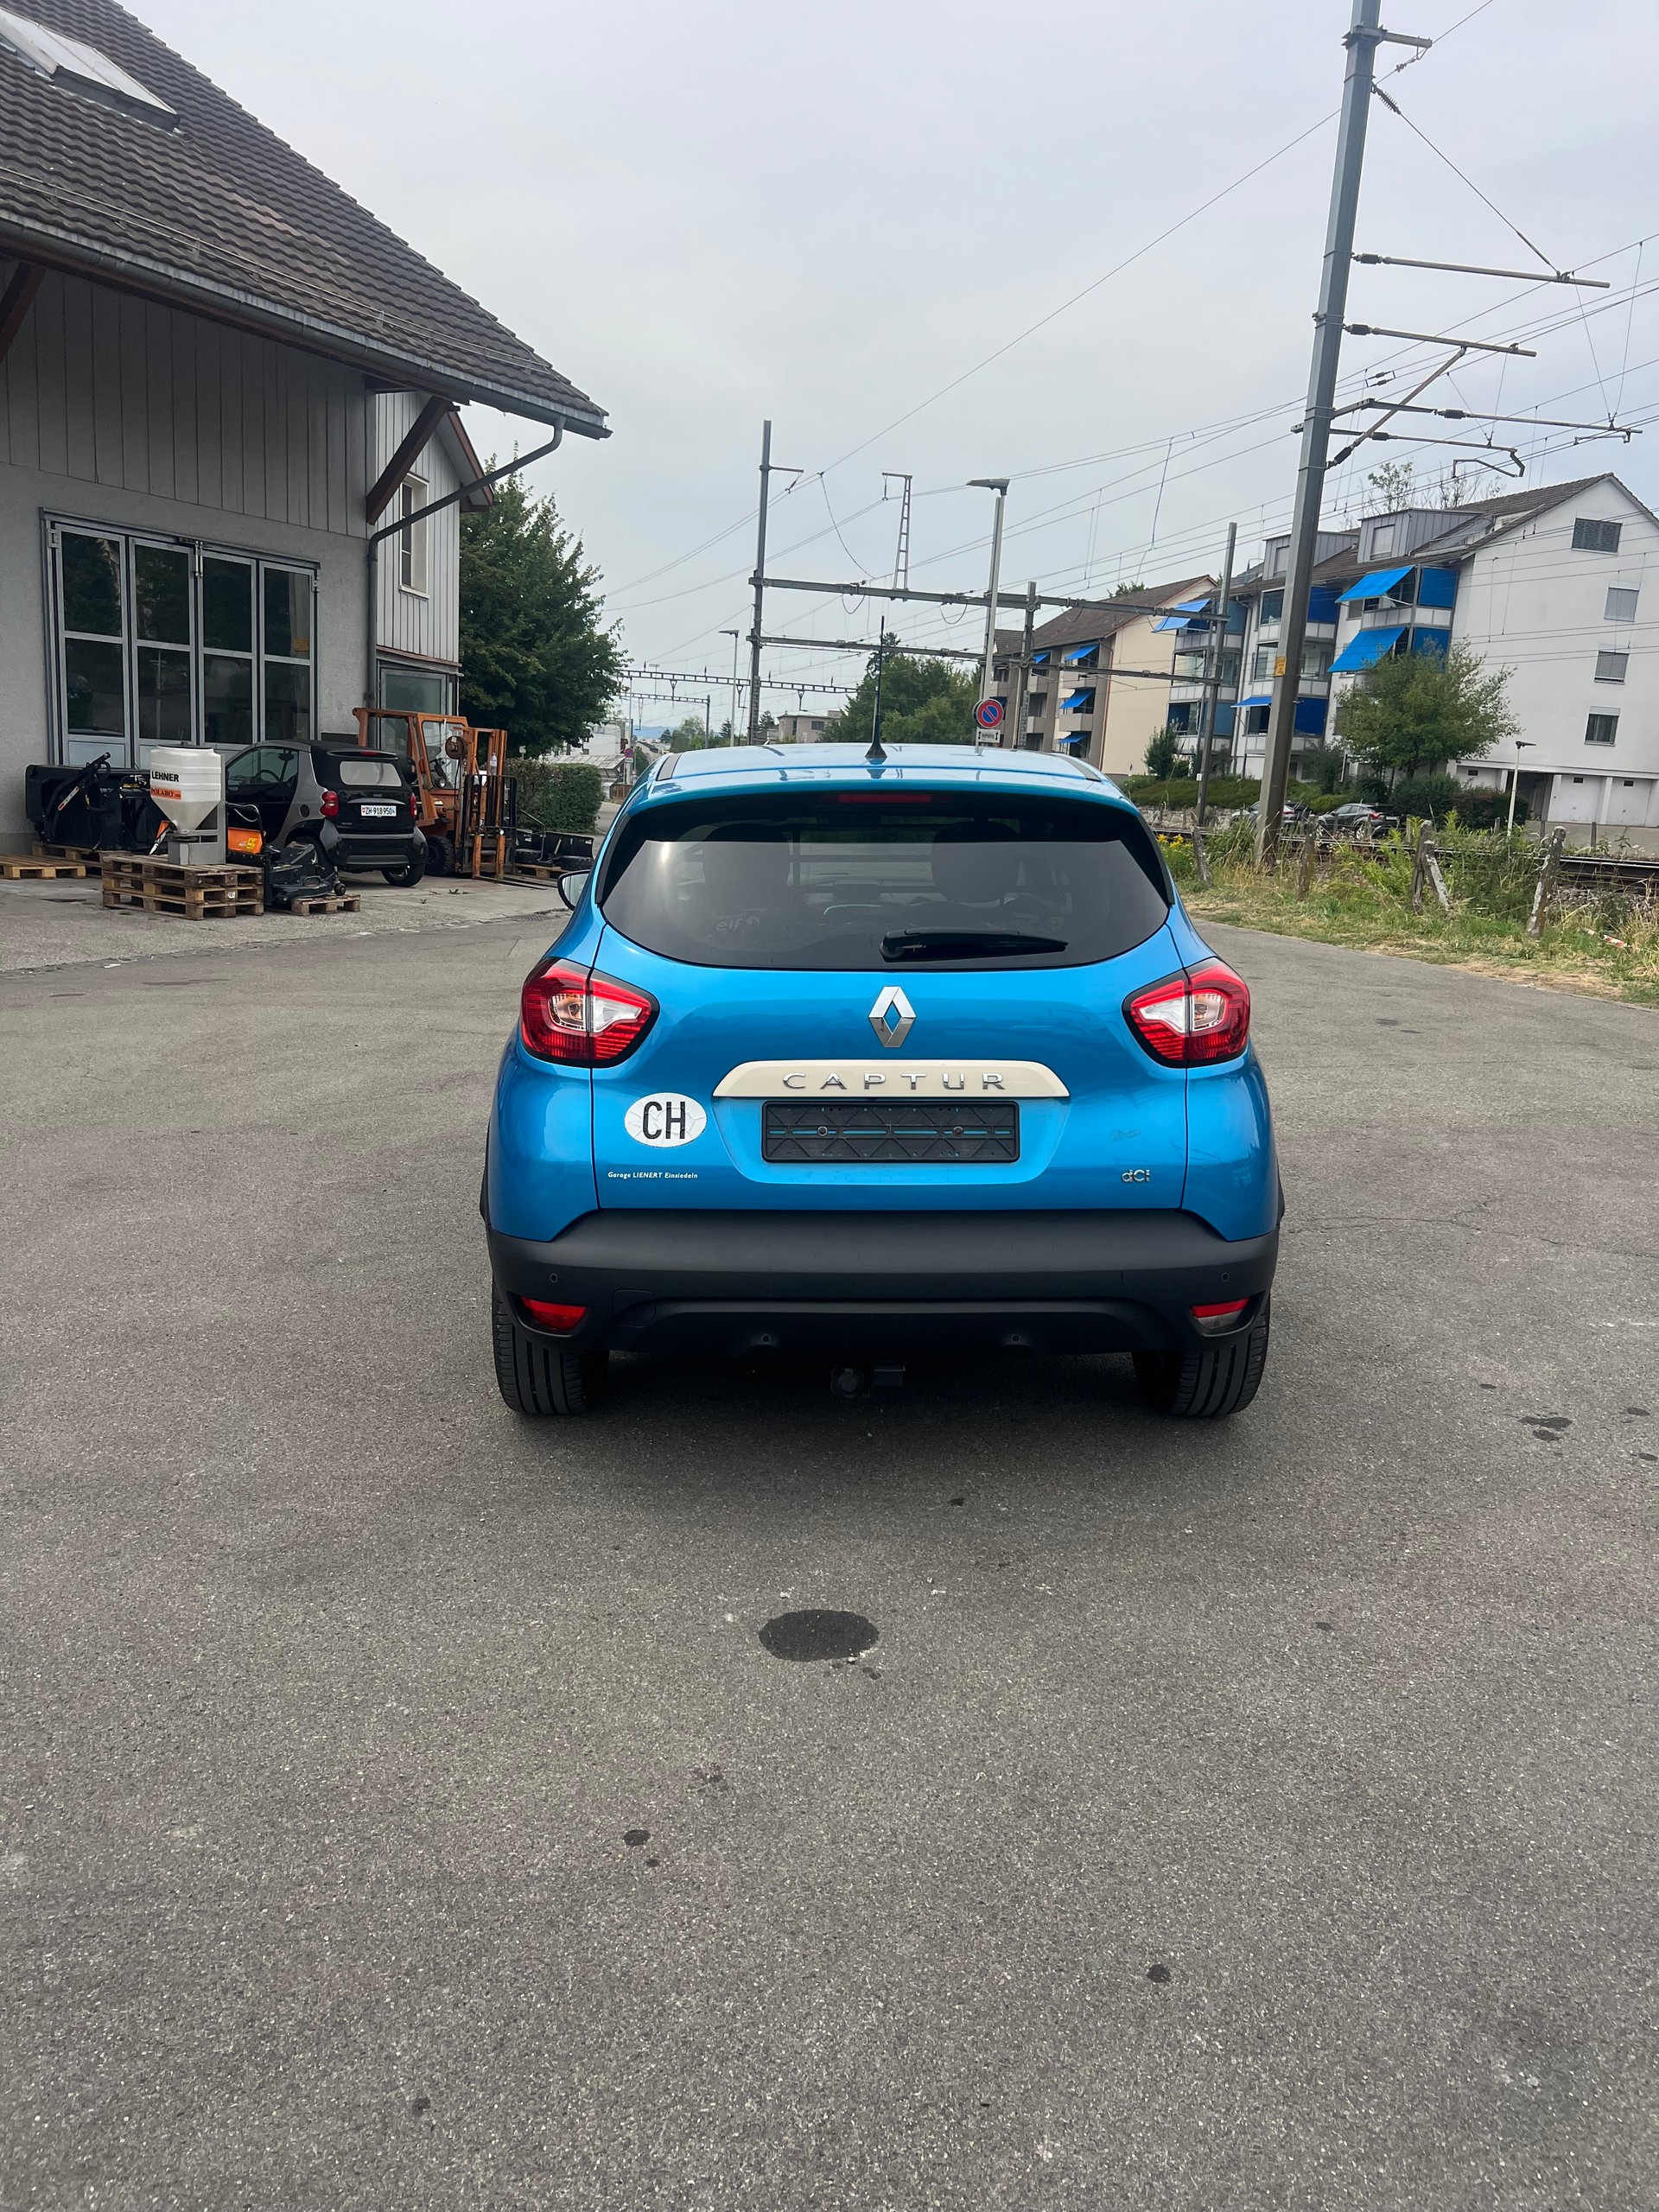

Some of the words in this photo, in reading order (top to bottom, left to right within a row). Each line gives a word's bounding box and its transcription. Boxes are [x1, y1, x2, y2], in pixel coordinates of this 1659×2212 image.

[151, 770, 180, 783] LEHNER
[783, 1072, 1006, 1090] CAPTUR
[642, 1101, 686, 1140] CH
[607, 1171, 631, 1179] Garage
